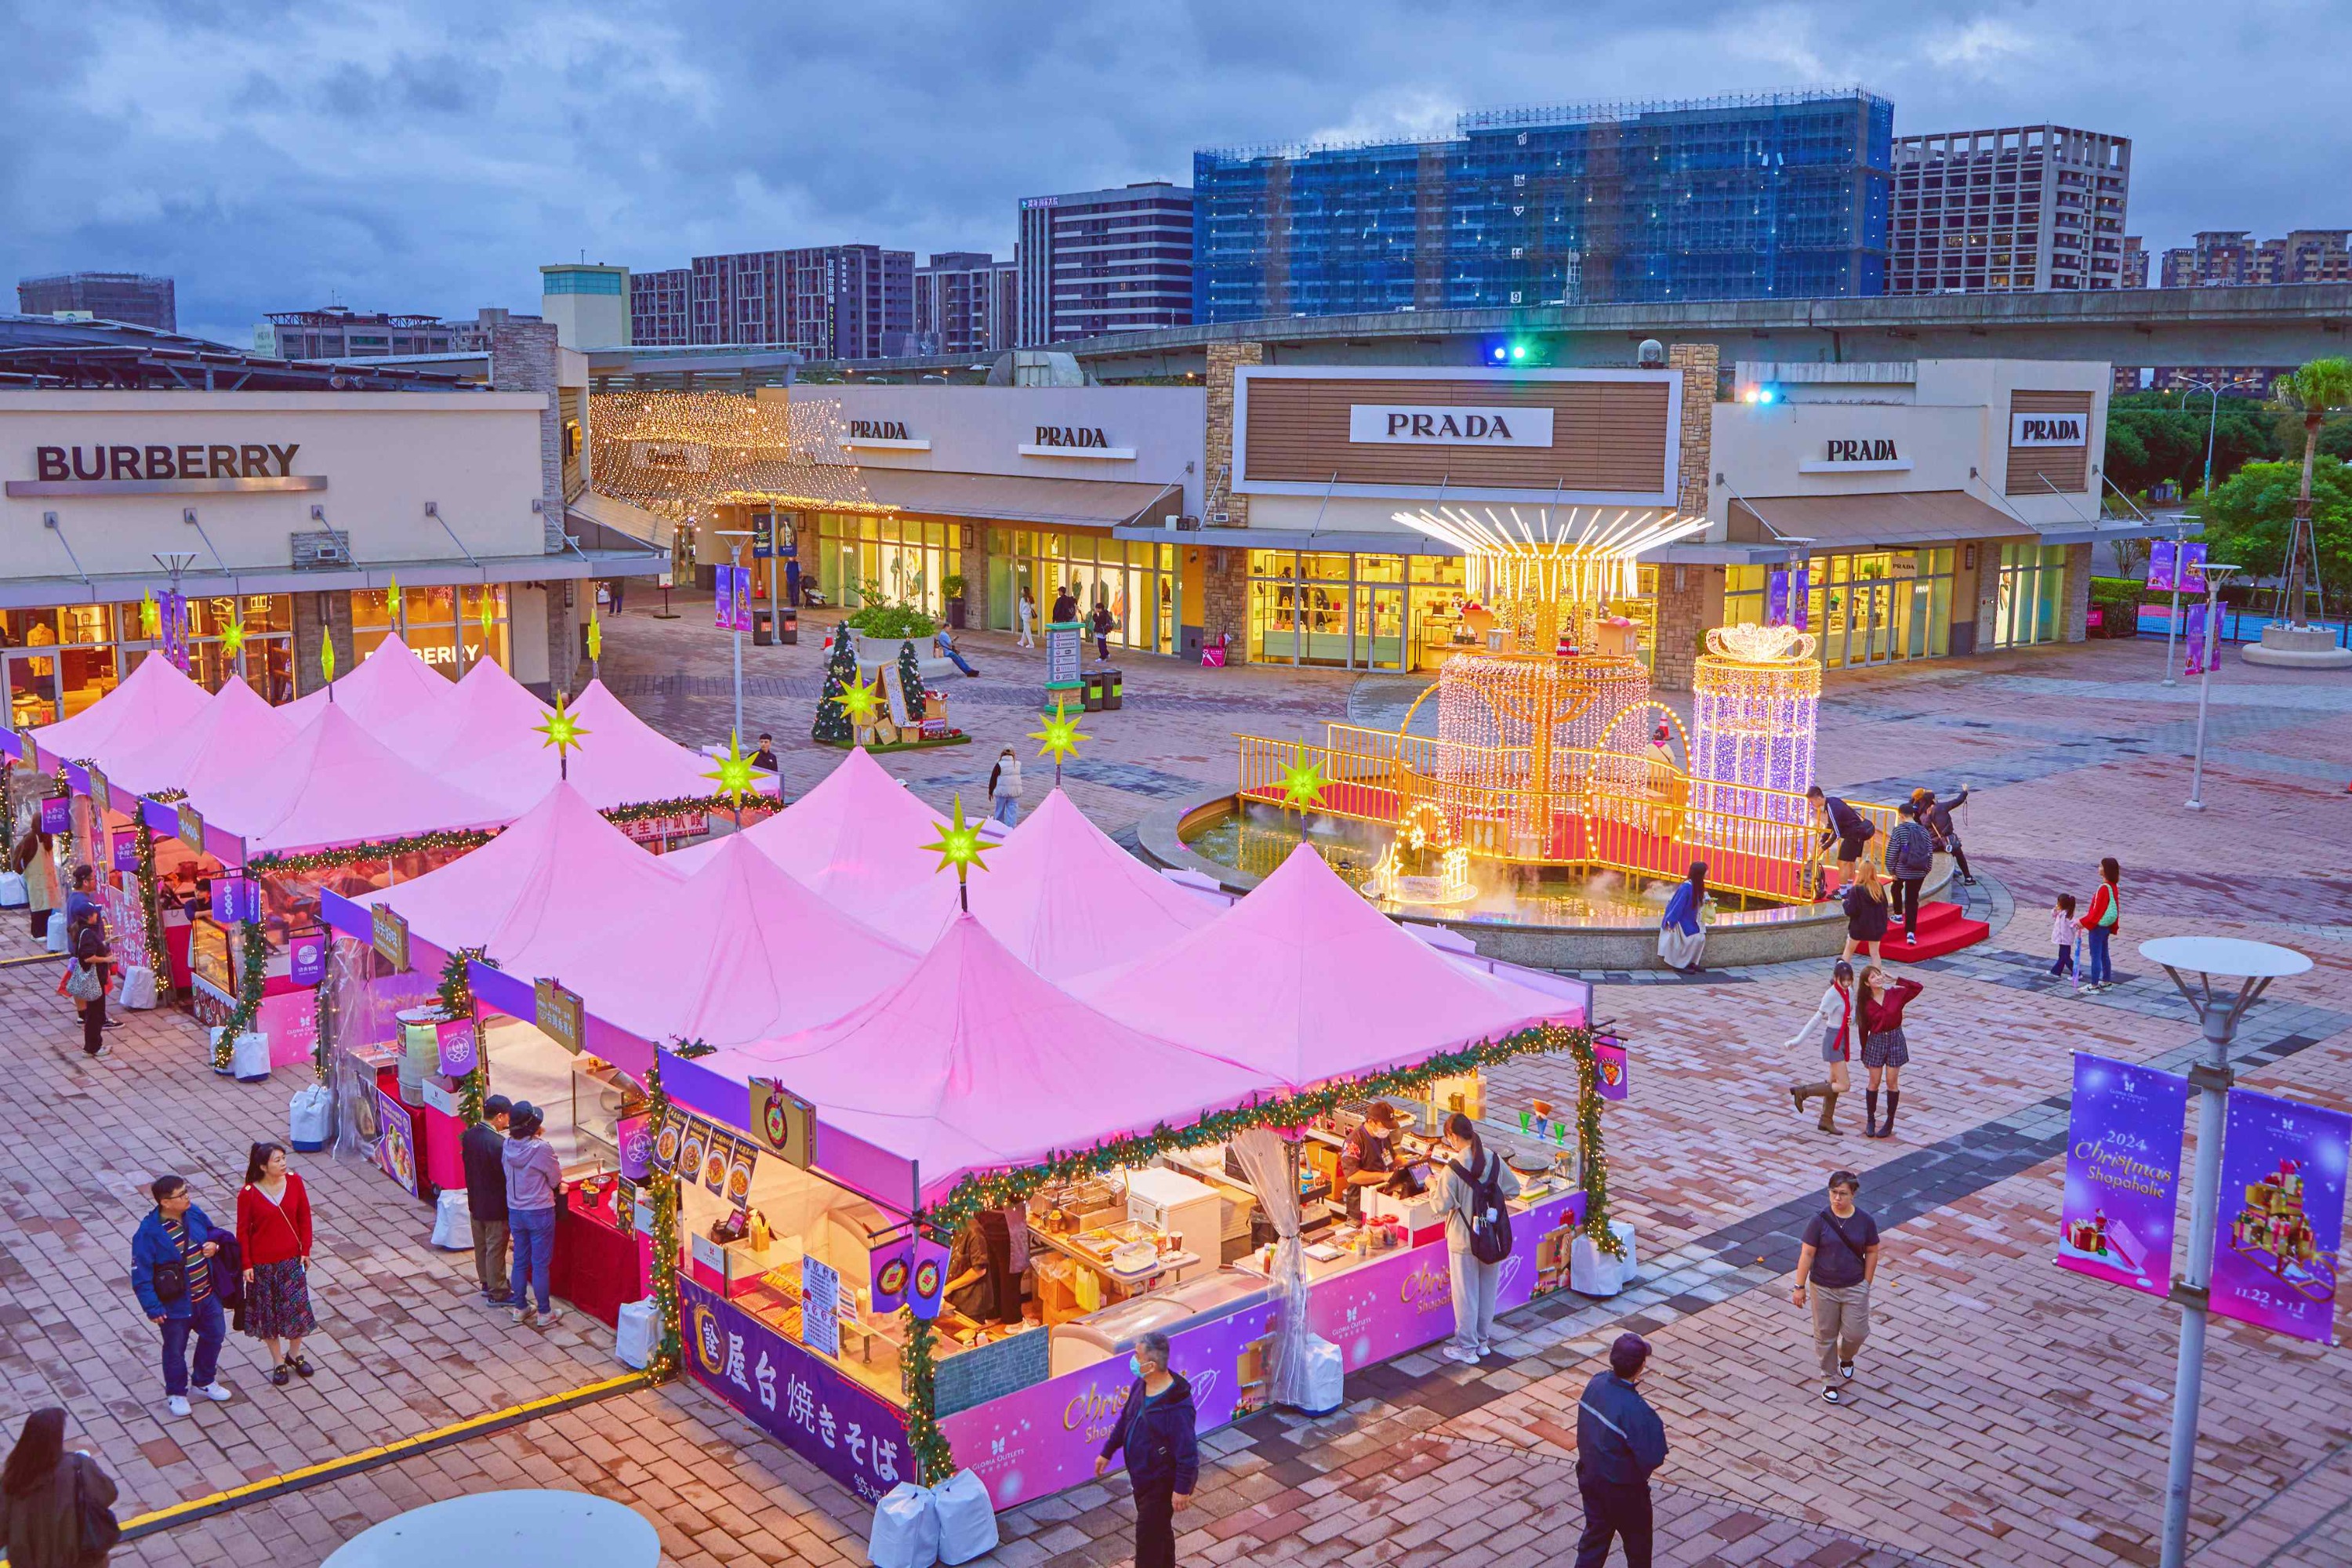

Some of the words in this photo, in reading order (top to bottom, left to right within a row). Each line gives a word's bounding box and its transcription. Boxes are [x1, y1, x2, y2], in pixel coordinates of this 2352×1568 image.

[1512, 292, 1519, 303] 9
[851, 420, 909, 441] PRADA
[1034, 426, 1109, 448] PRADA
[1387, 413, 1513, 438] PRADA
[2022, 419, 2081, 441] PRADA
[1827, 439, 1898, 462] PRADA
[37, 444, 300, 481] BURBERRY
[2105, 1130, 2147, 1152] 2024
[2074, 1140, 2172, 1181] Christmas
[2086, 1165, 2165, 1199] Shopaholic
[2234, 1287, 2270, 1304] 11.22
[725, 1330, 899, 1483] 屋台焼きそば
[972, 1458, 996, 1471] GLORIA
[996, 1448, 1025, 1462] OUTLETS
